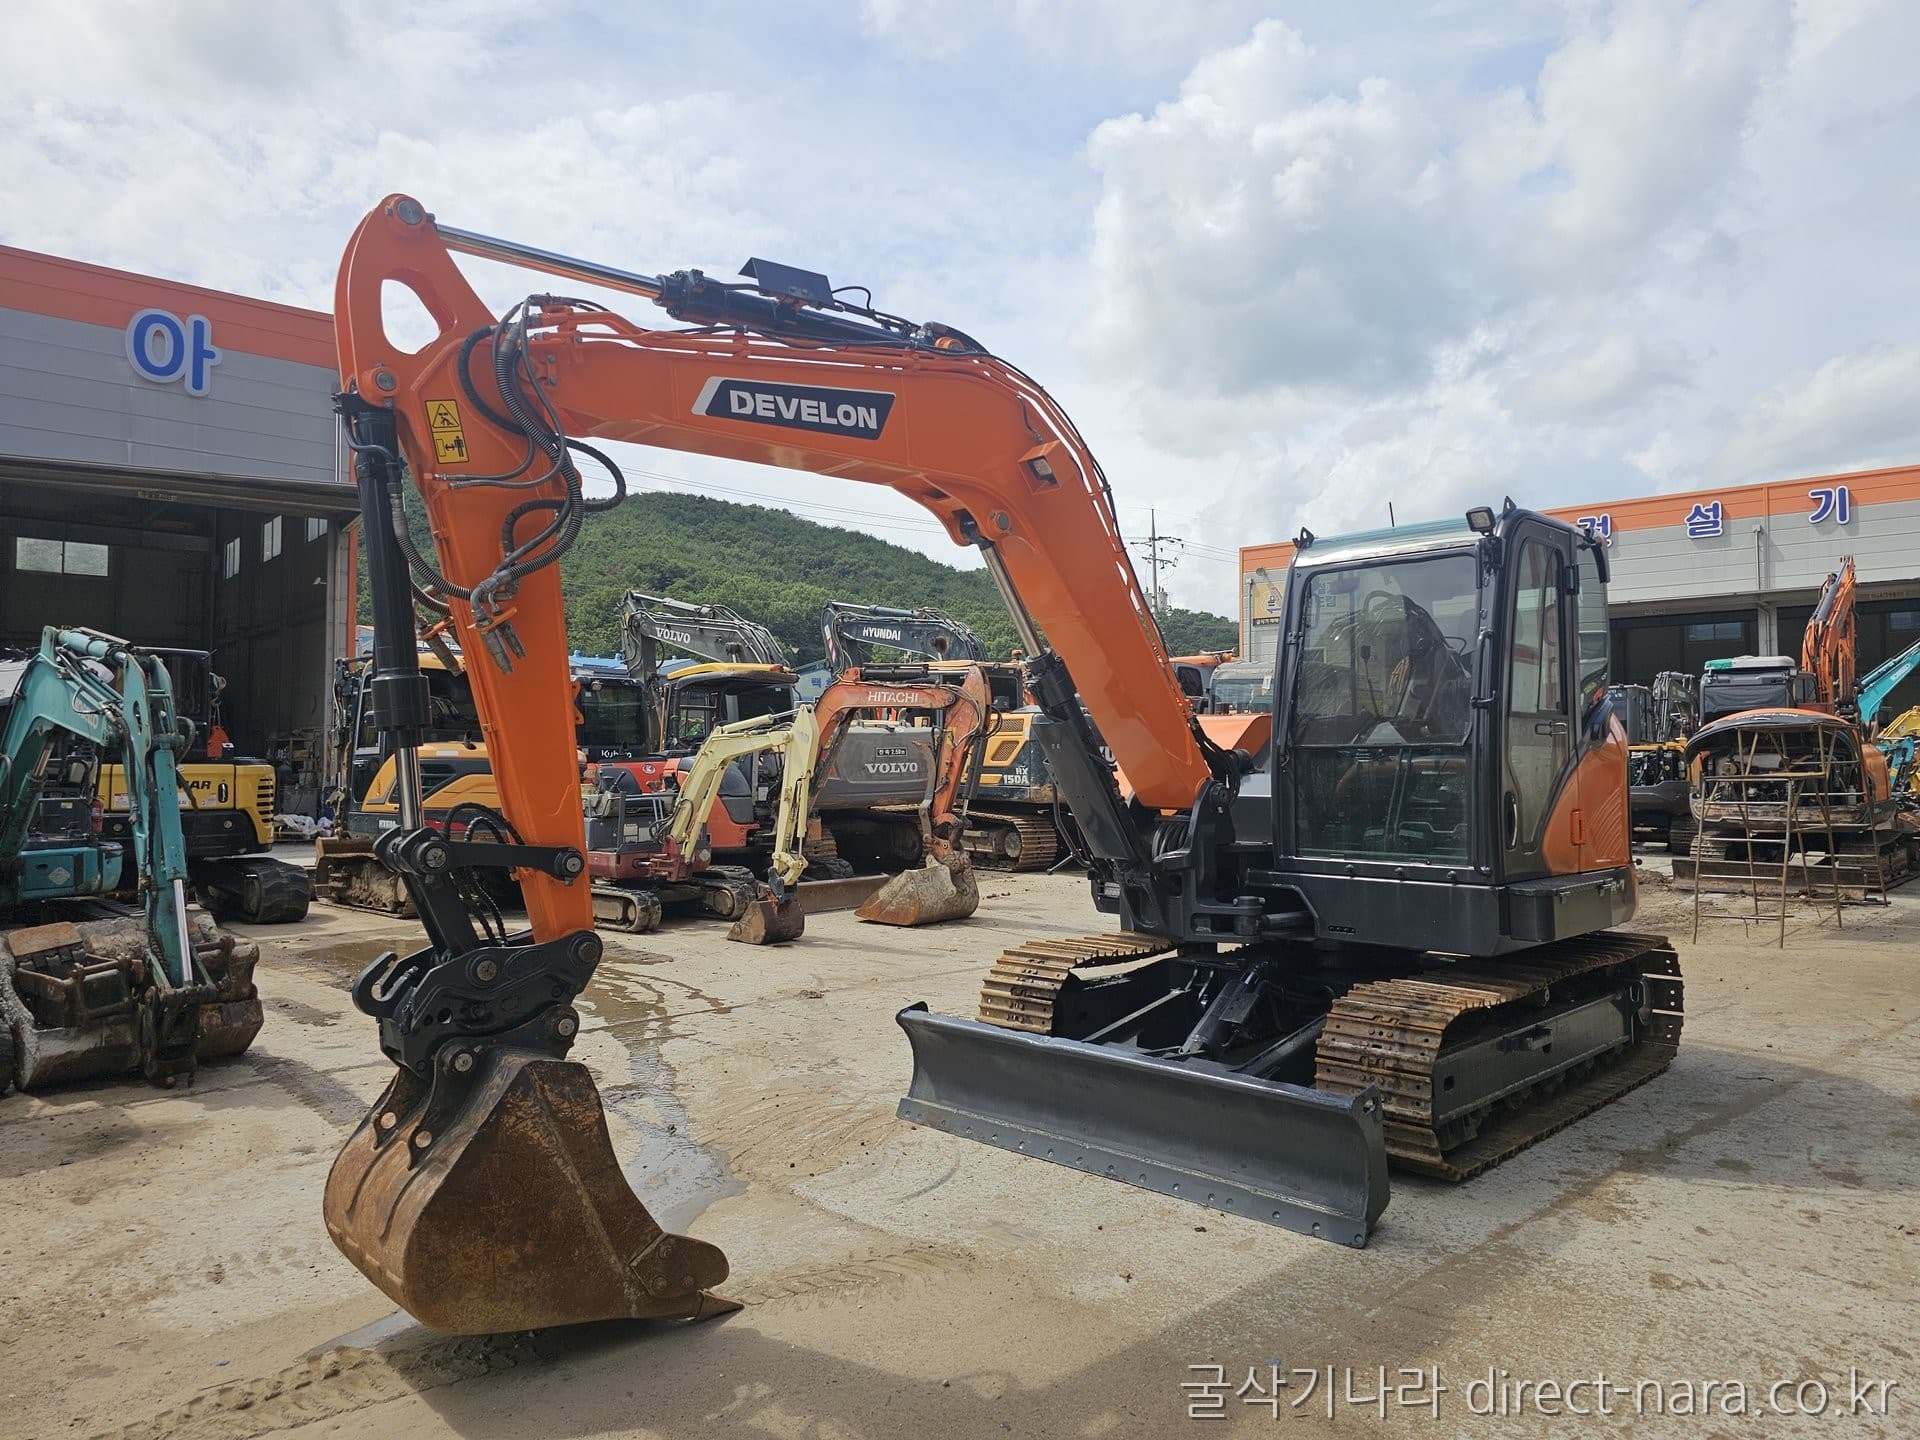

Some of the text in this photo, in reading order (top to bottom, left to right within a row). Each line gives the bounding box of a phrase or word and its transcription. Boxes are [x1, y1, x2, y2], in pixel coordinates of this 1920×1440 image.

[128, 309, 221, 396] 아
[729, 390, 878, 429] DEVELON
[1685, 501, 1723, 538] 설
[1809, 486, 1849, 523] 기
[656, 627, 691, 644] VOLVO
[862, 626, 902, 641] HYUNDAI
[868, 691, 918, 703] HITACHI
[865, 762, 918, 774] VOLVO
[1003, 774, 1030, 785] 150A
